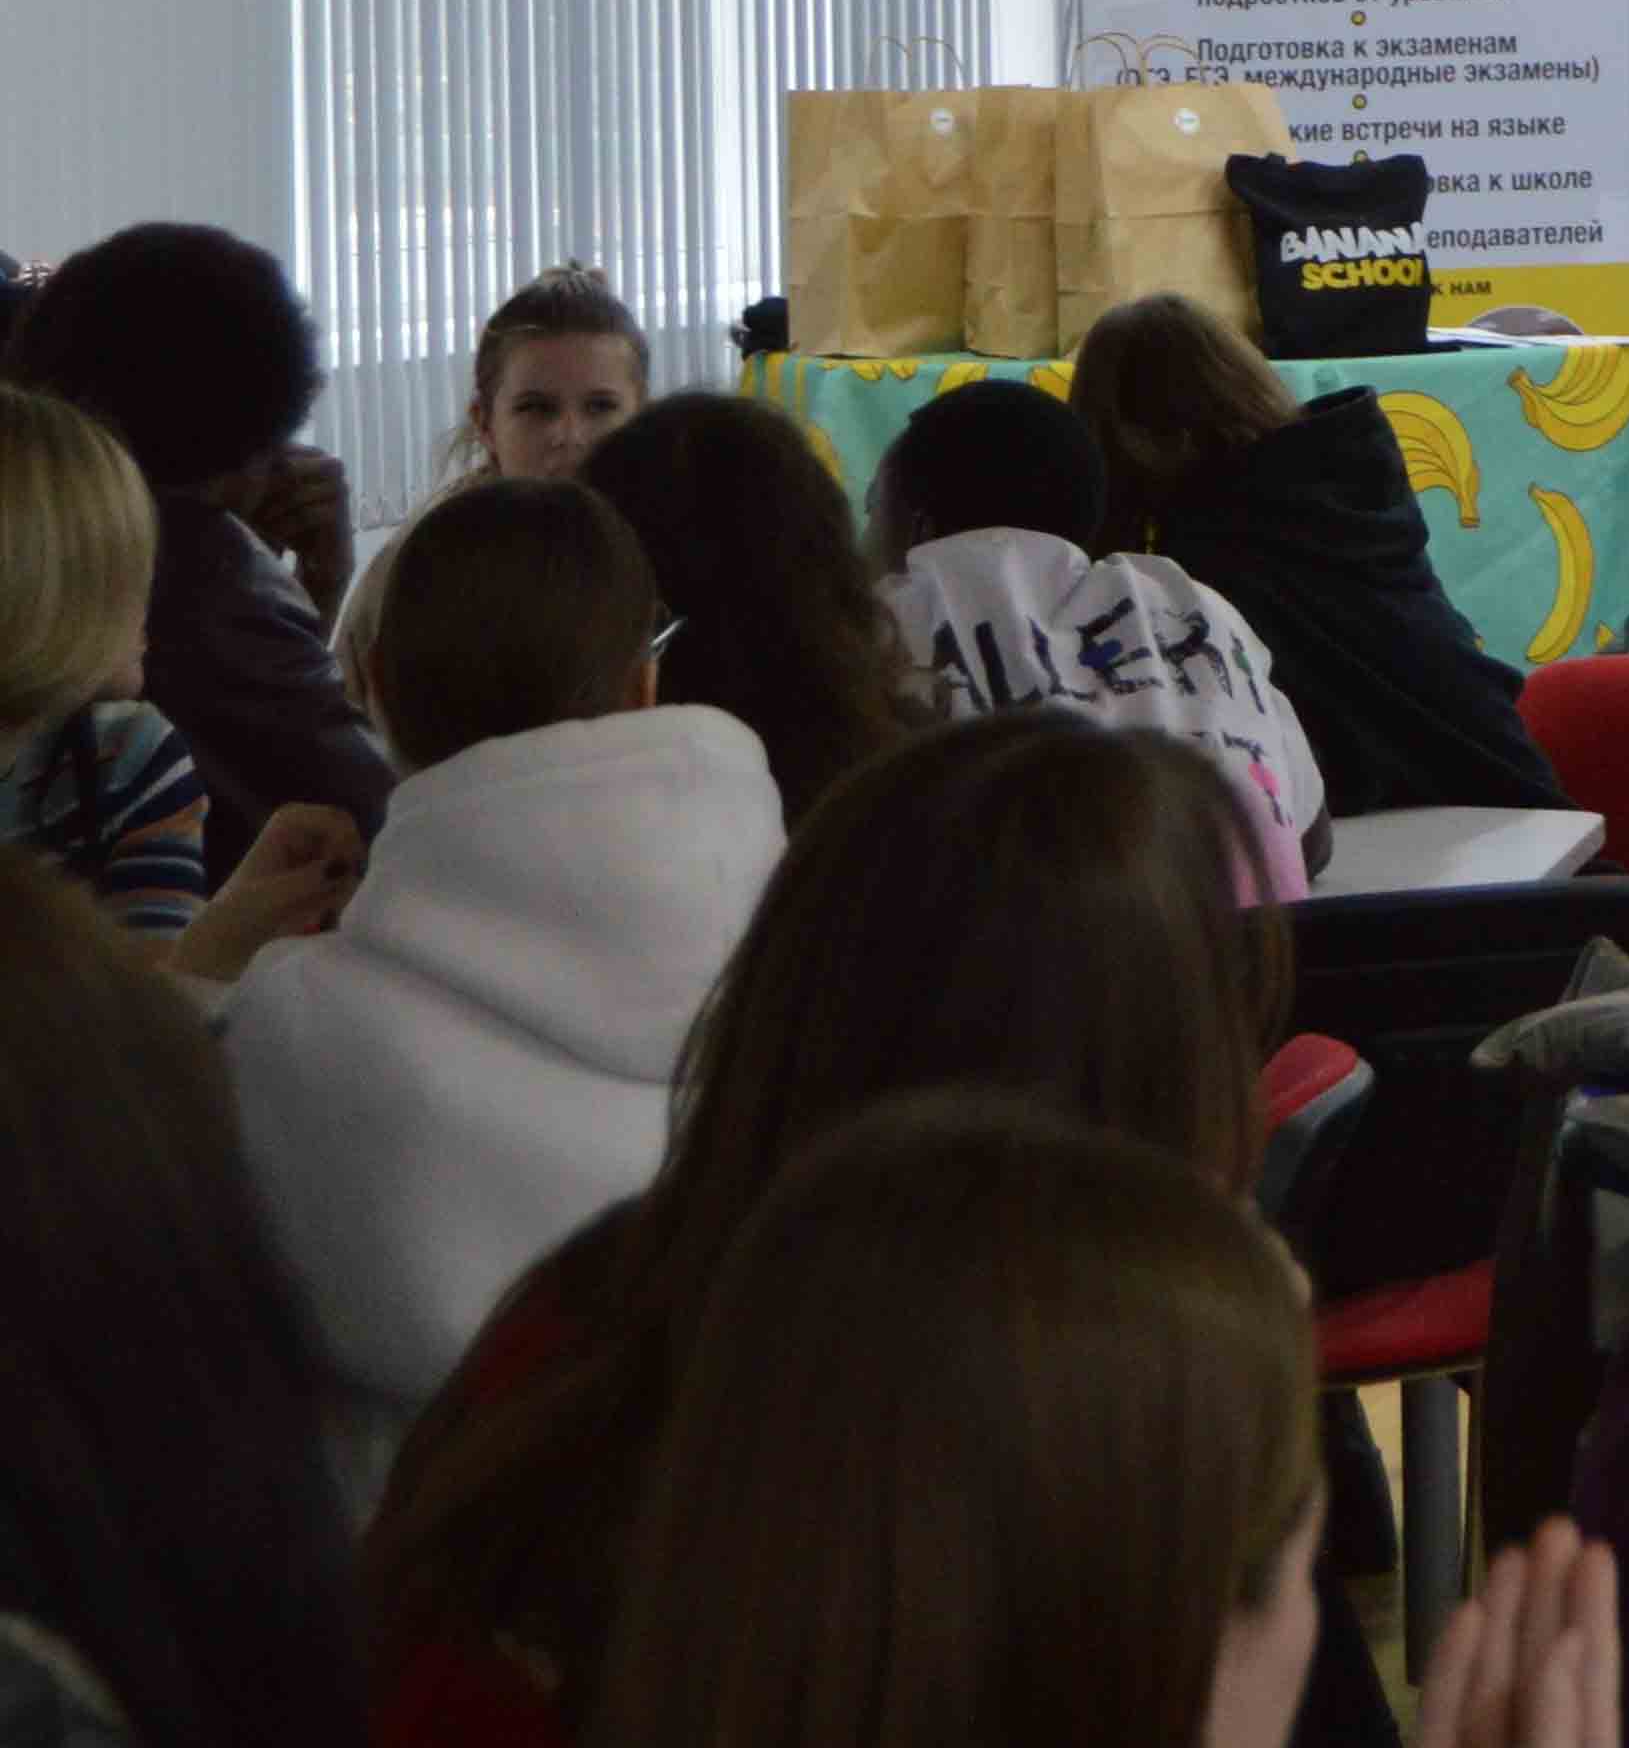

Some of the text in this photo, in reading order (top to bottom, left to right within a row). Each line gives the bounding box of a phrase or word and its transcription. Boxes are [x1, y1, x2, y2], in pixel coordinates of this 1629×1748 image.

[1199, 34, 1517, 65] Подготовка к экзаменам
[1244, 60, 1457, 91] международные
[1463, 55, 1600, 83] экзамены)
[1288, 114, 1565, 146] кие встречи на языке
[1426, 169, 1593, 194] овка к школе
[1426, 219, 1604, 251] еподавателей
